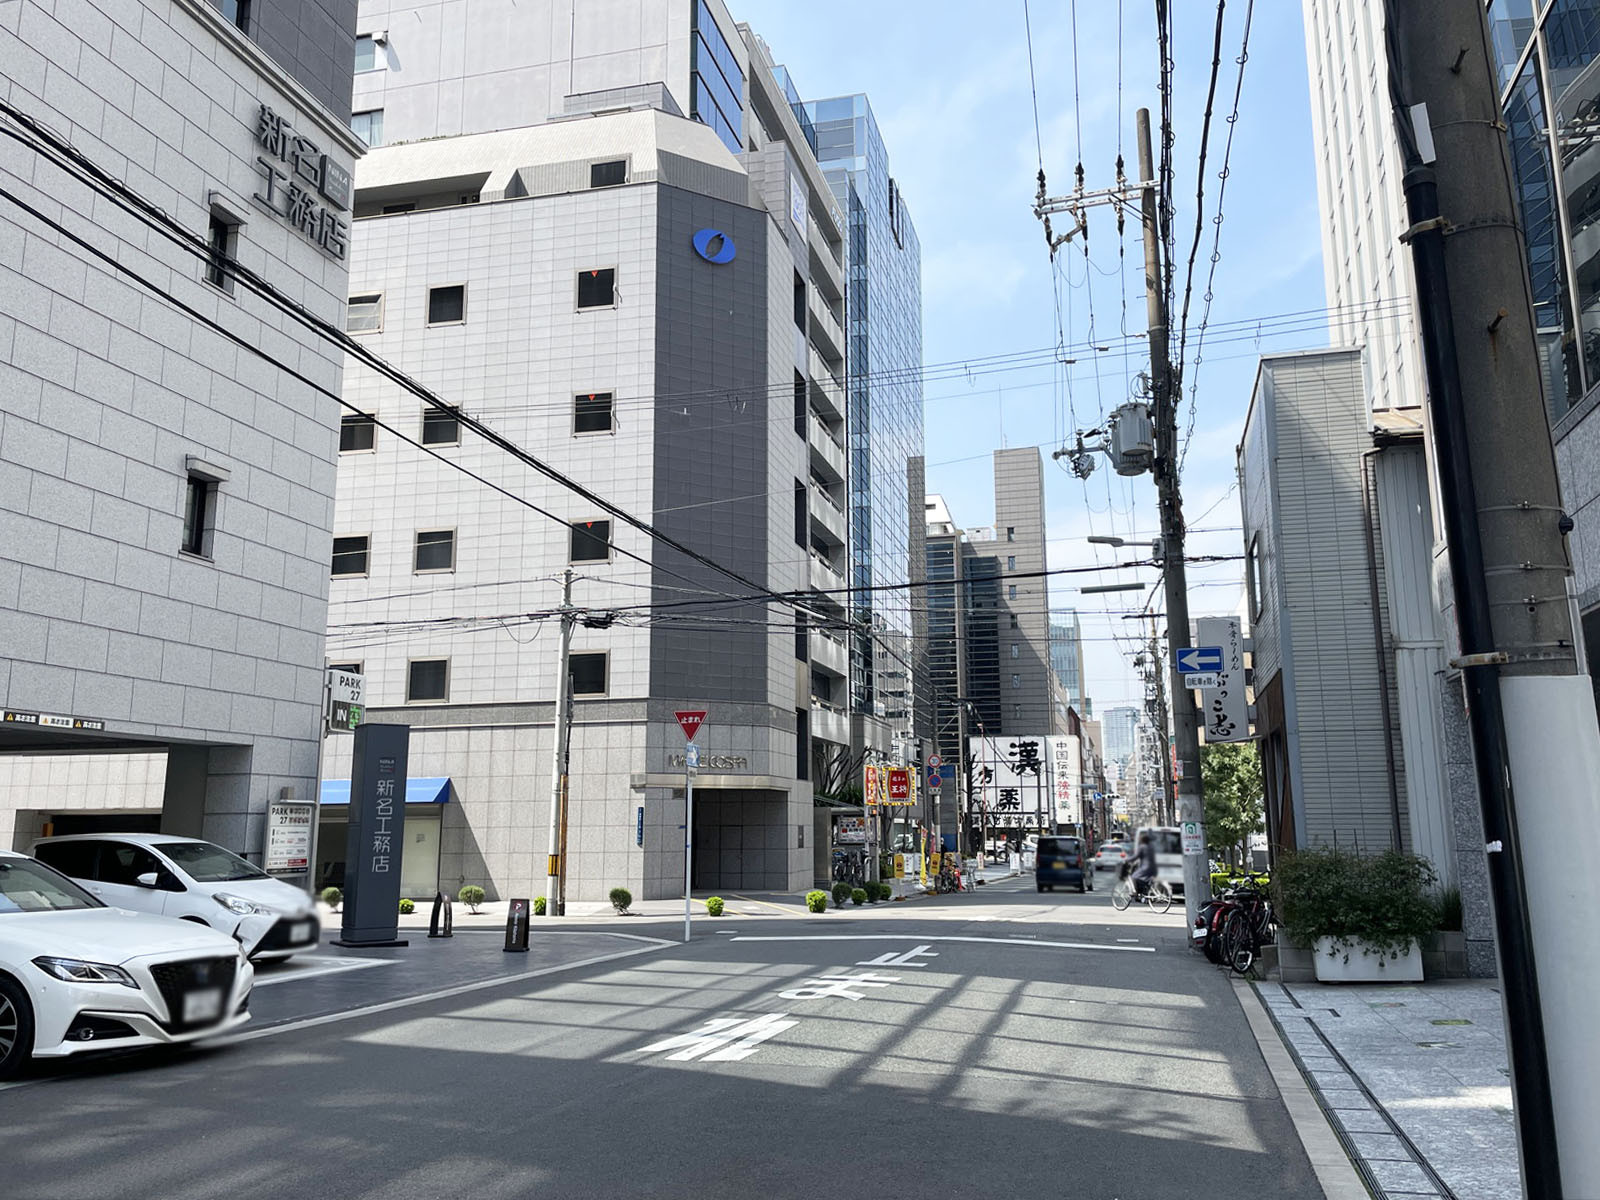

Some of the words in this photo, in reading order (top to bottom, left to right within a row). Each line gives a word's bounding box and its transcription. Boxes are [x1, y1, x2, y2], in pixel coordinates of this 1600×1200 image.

[258, 104, 321, 188] 新名
[253, 157, 347, 261] 工務店
[339, 675, 361, 690] PARK
[350, 690, 361, 702] 27
[336, 708, 348, 723] IN
[680, 715, 701, 724] 止まれ
[891, 785, 907, 793] 王将
[271, 807, 289, 816] PARK
[279, 816, 288, 825] 27
[371, 779, 395, 872] 新名工務店
[634, 944, 939, 1062] 止まれ
